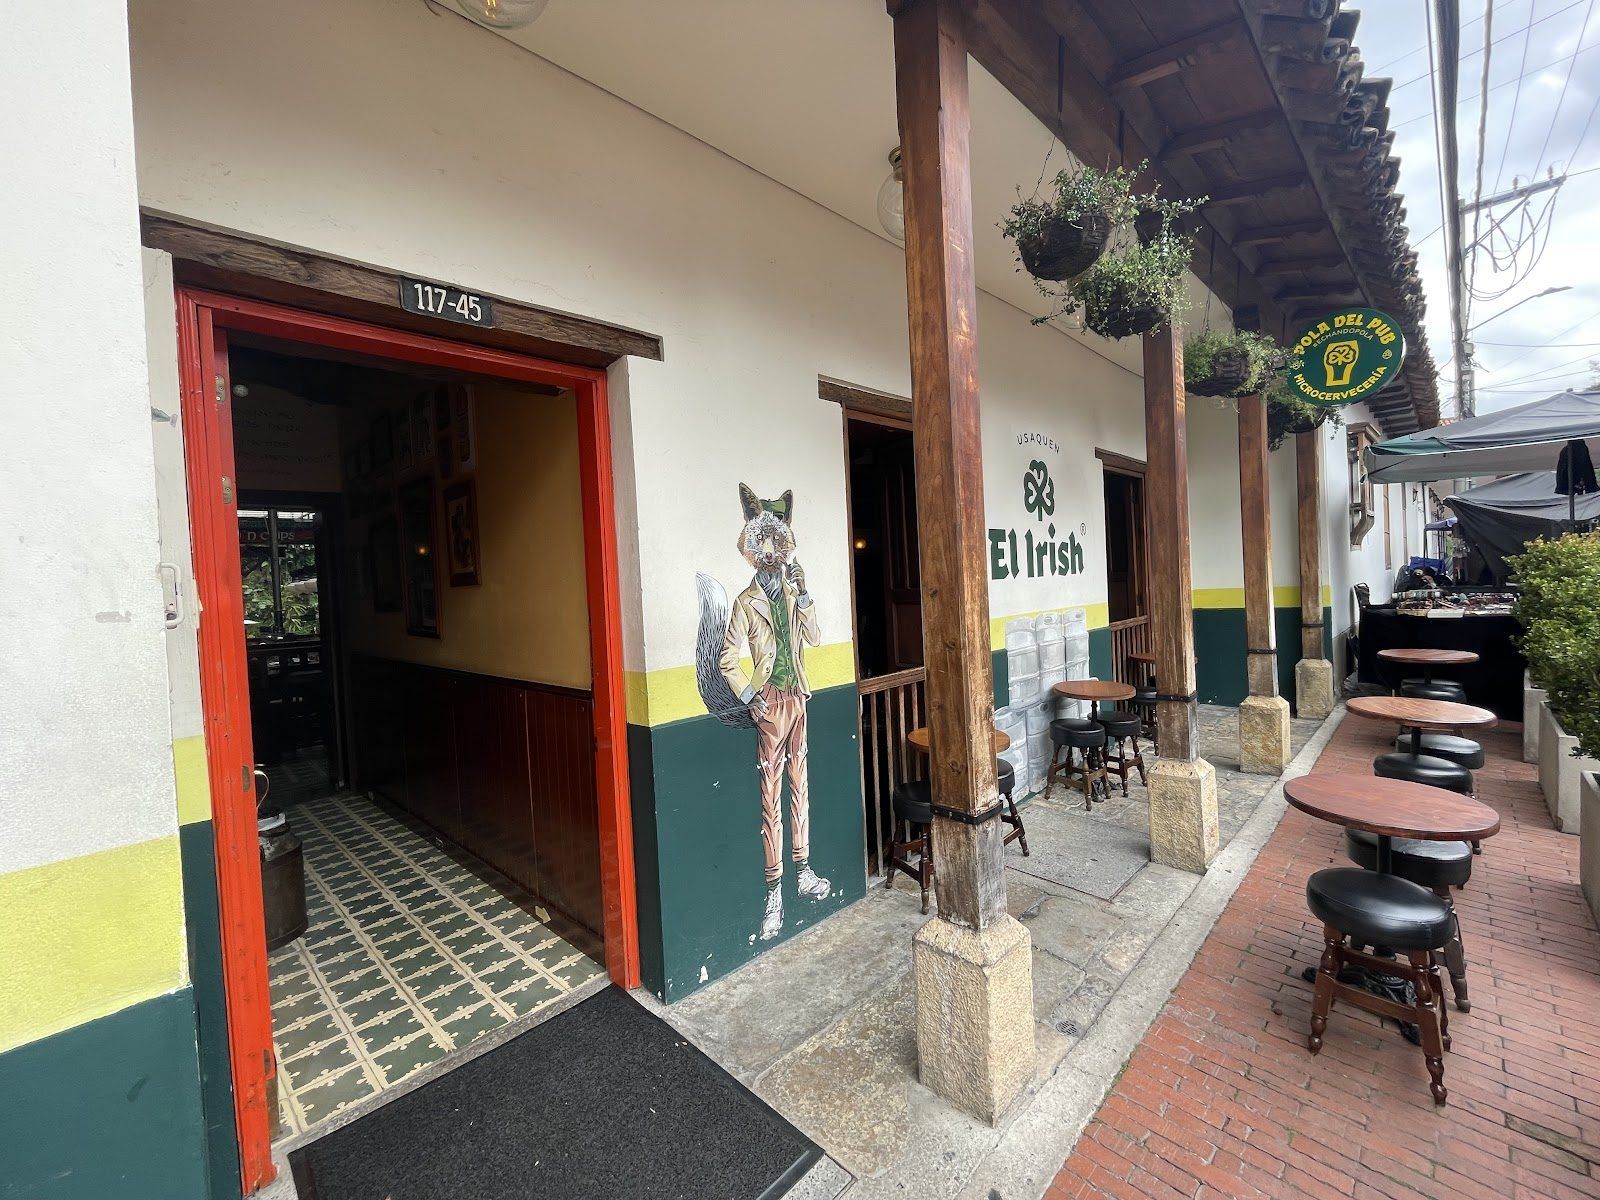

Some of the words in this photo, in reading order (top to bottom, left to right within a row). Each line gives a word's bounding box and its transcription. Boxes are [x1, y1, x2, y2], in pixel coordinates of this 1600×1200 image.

[414, 283, 482, 321] 117-45
[1293, 321, 1331, 355] POLA
[1335, 313, 1364, 328] DEL
[1366, 317, 1396, 345] PUB
[1016, 433, 1060, 454] USAQUEN
[260, 531, 295, 541] CIPS
[988, 528, 1020, 580] El
[1024, 522, 1085, 578] Irish
